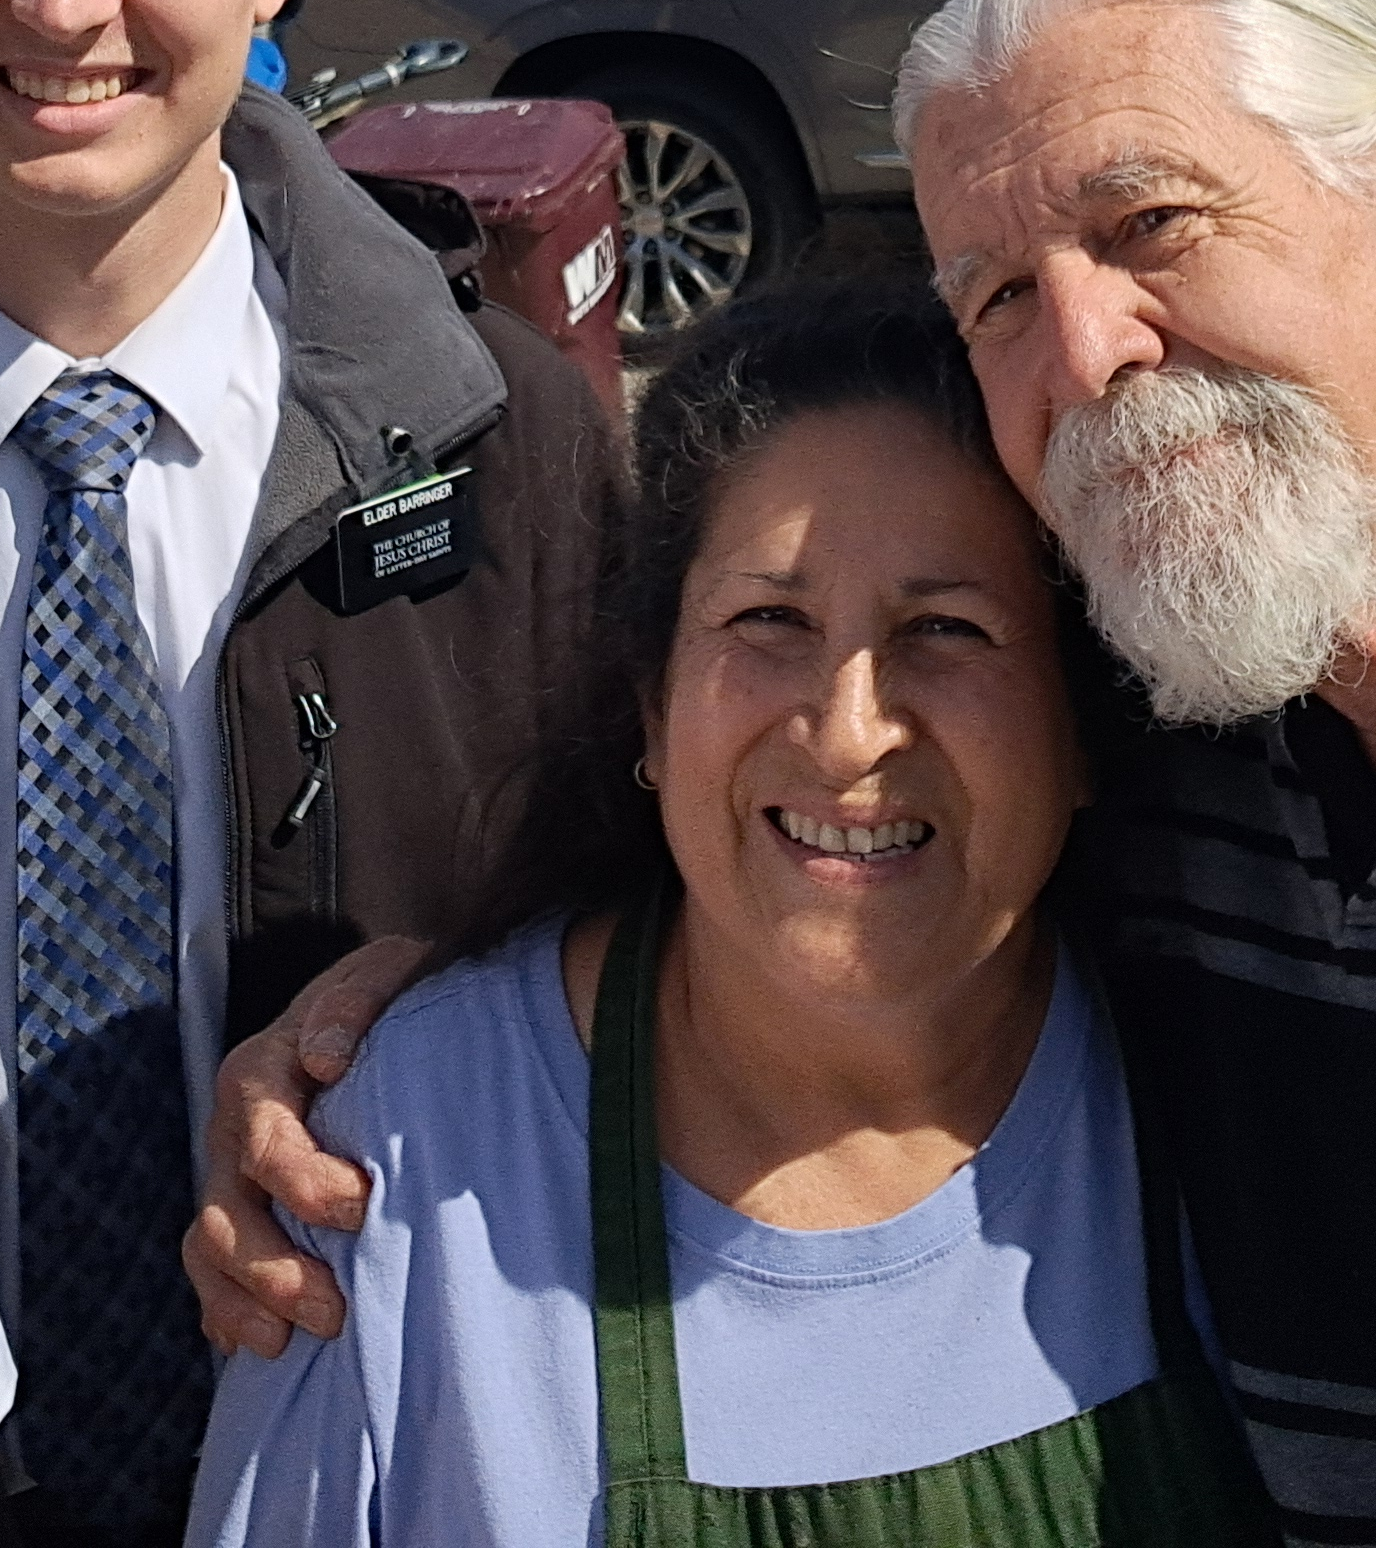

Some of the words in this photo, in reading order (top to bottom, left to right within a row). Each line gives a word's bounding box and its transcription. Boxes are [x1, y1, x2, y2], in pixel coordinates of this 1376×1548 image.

[362, 502, 397, 527] ELDER
[398, 482, 453, 514] BARRINGER
[374, 547, 407, 571] JESUS
[408, 530, 451, 556] CHRIST
[395, 524, 437, 546] CHURCH
